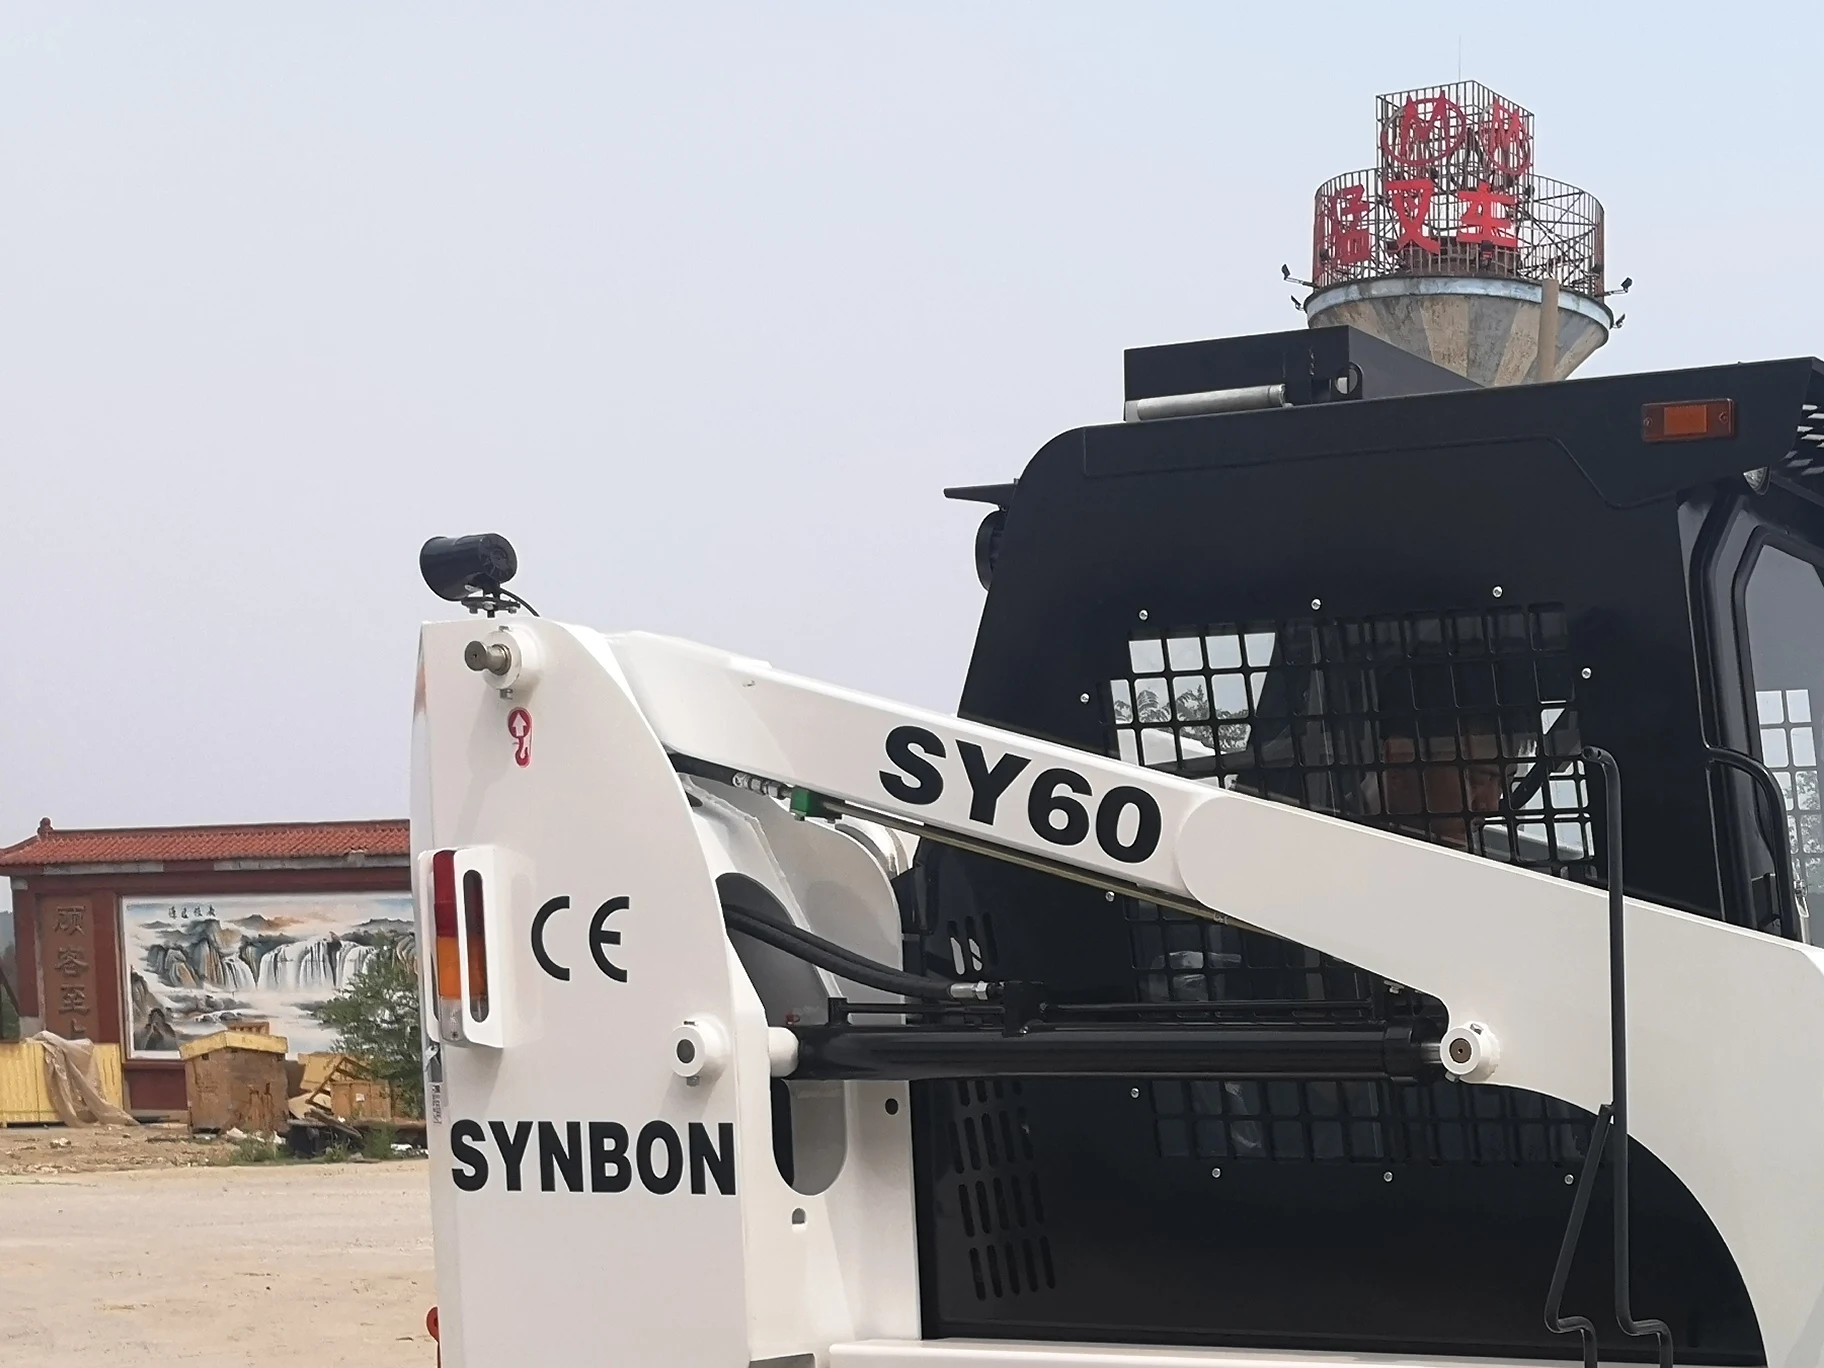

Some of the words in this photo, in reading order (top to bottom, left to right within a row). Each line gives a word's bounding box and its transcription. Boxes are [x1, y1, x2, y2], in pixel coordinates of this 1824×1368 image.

[877, 724, 1163, 865] SY60
[530, 894, 631, 984] CE
[449, 1118, 737, 1197] SYNBON
